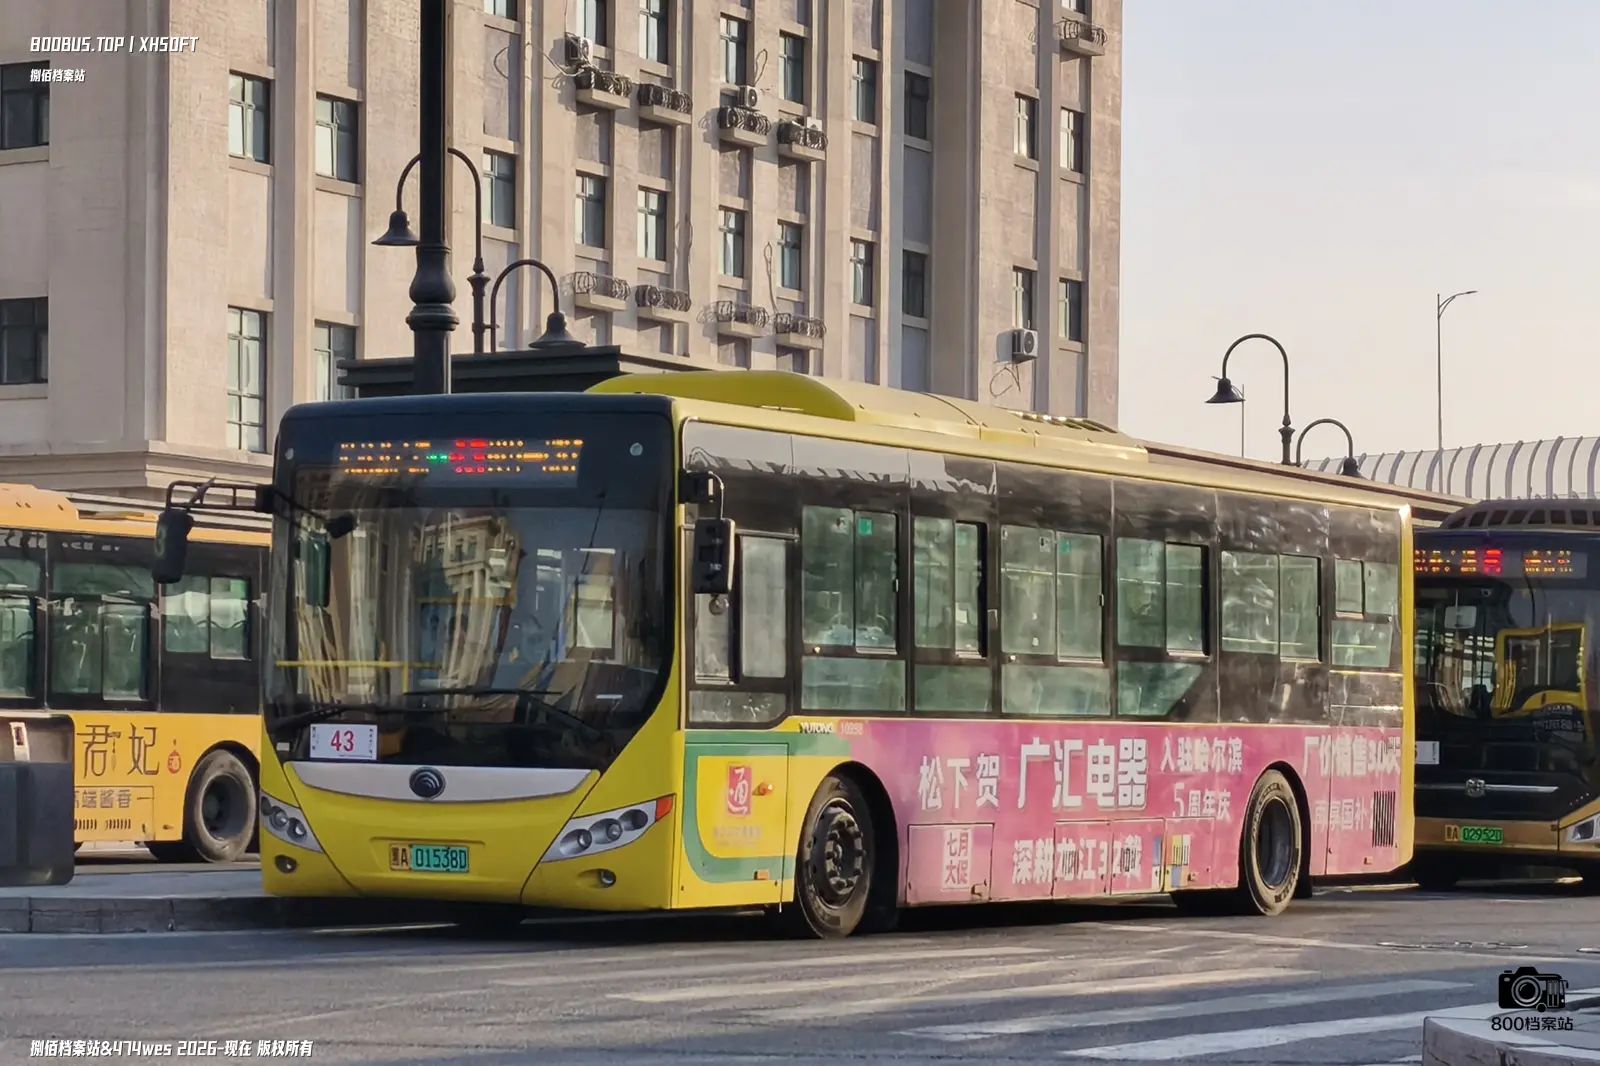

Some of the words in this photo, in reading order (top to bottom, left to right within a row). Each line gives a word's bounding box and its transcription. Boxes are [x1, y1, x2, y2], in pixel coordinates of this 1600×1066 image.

[76, 723, 160, 779] 君妃
[330, 729, 355, 752] 43
[917, 753, 1000, 811] 松下贺
[1017, 736, 1149, 811] 广汇电器
[1172, 782, 1231, 821] 5周年庆
[945, 832, 969, 857] 七月
[944, 859, 969, 885] 大促
